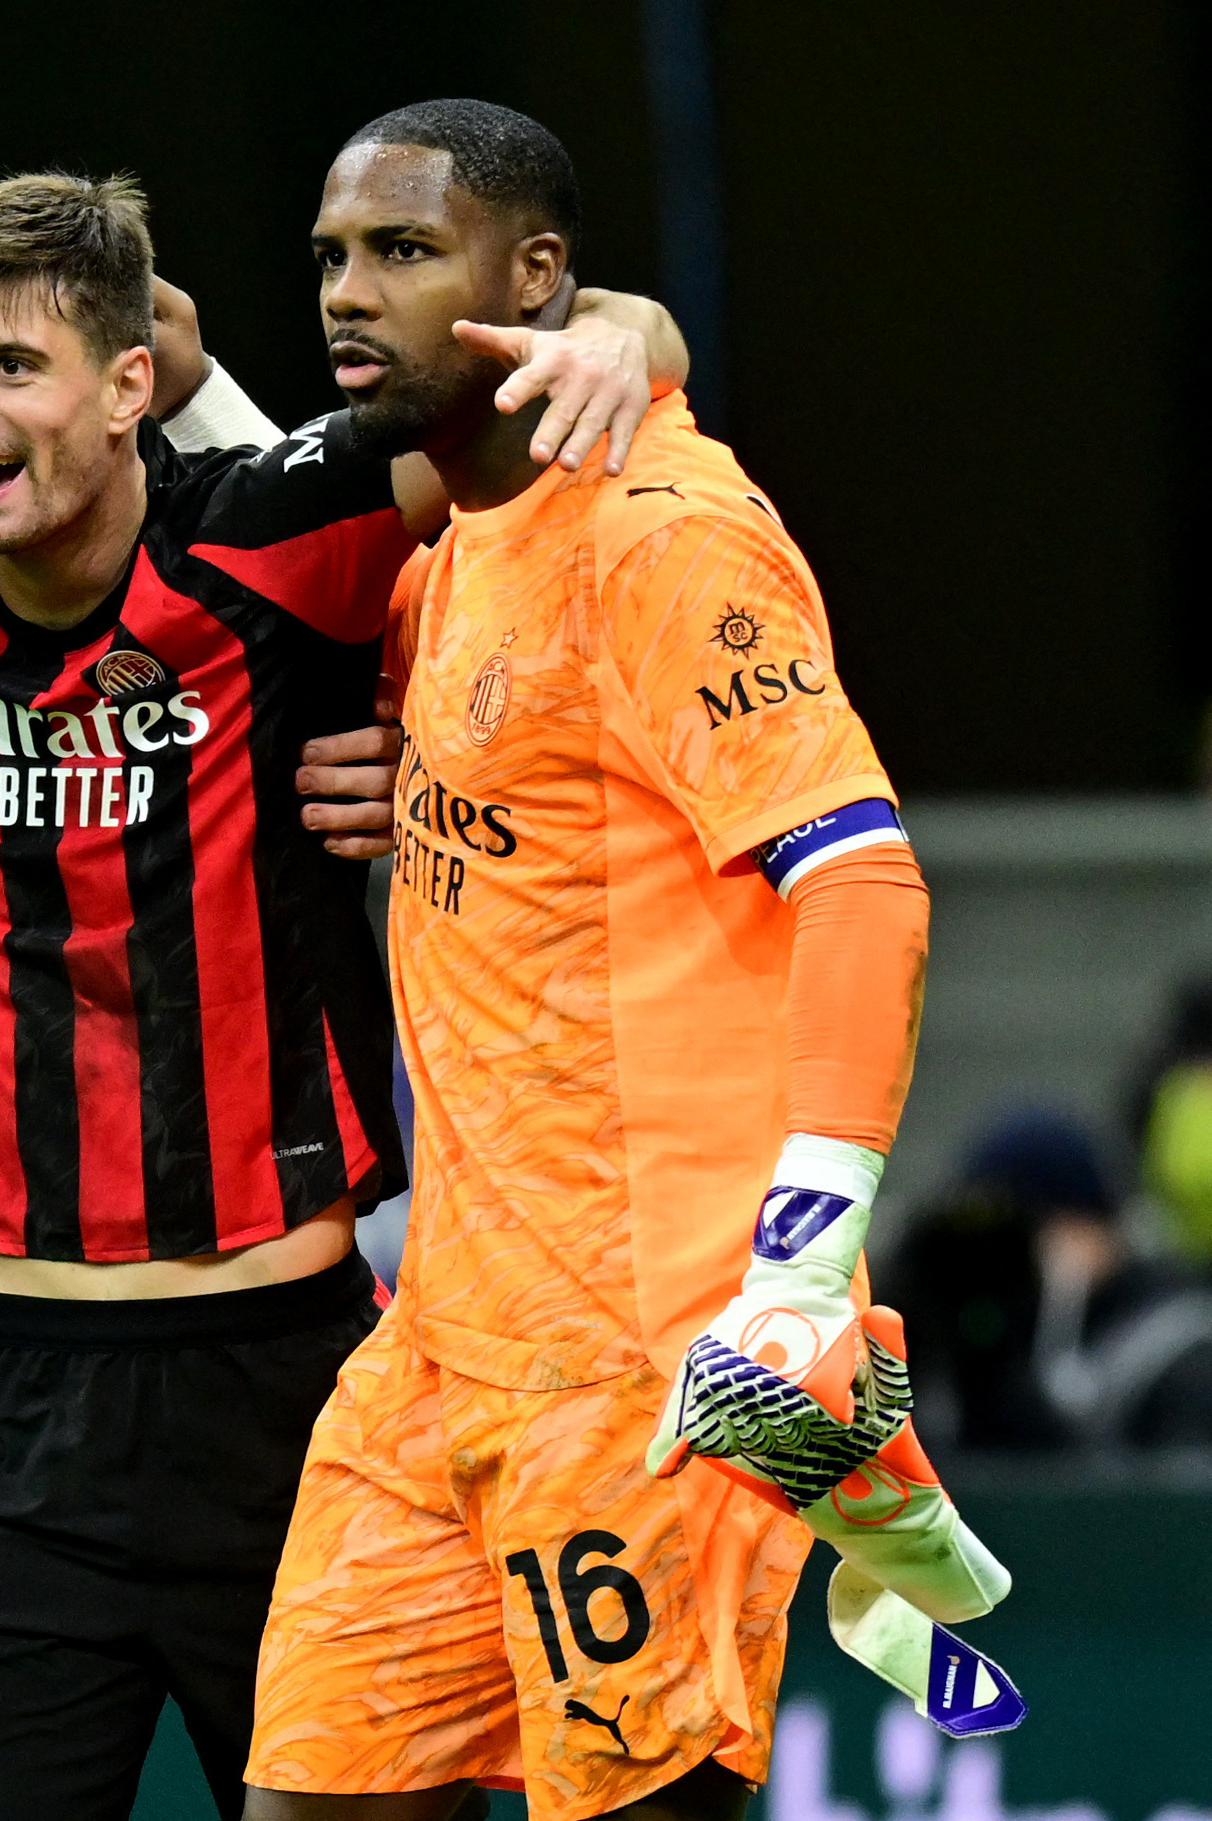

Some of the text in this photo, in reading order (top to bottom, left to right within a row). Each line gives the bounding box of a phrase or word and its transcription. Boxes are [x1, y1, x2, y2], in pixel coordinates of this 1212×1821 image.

[103, 655, 130, 676] ACM
[695, 658, 826, 731] MSC
[271, 1142, 324, 1160] ULTRAWEAVE
[505, 1529, 650, 1684] 16
